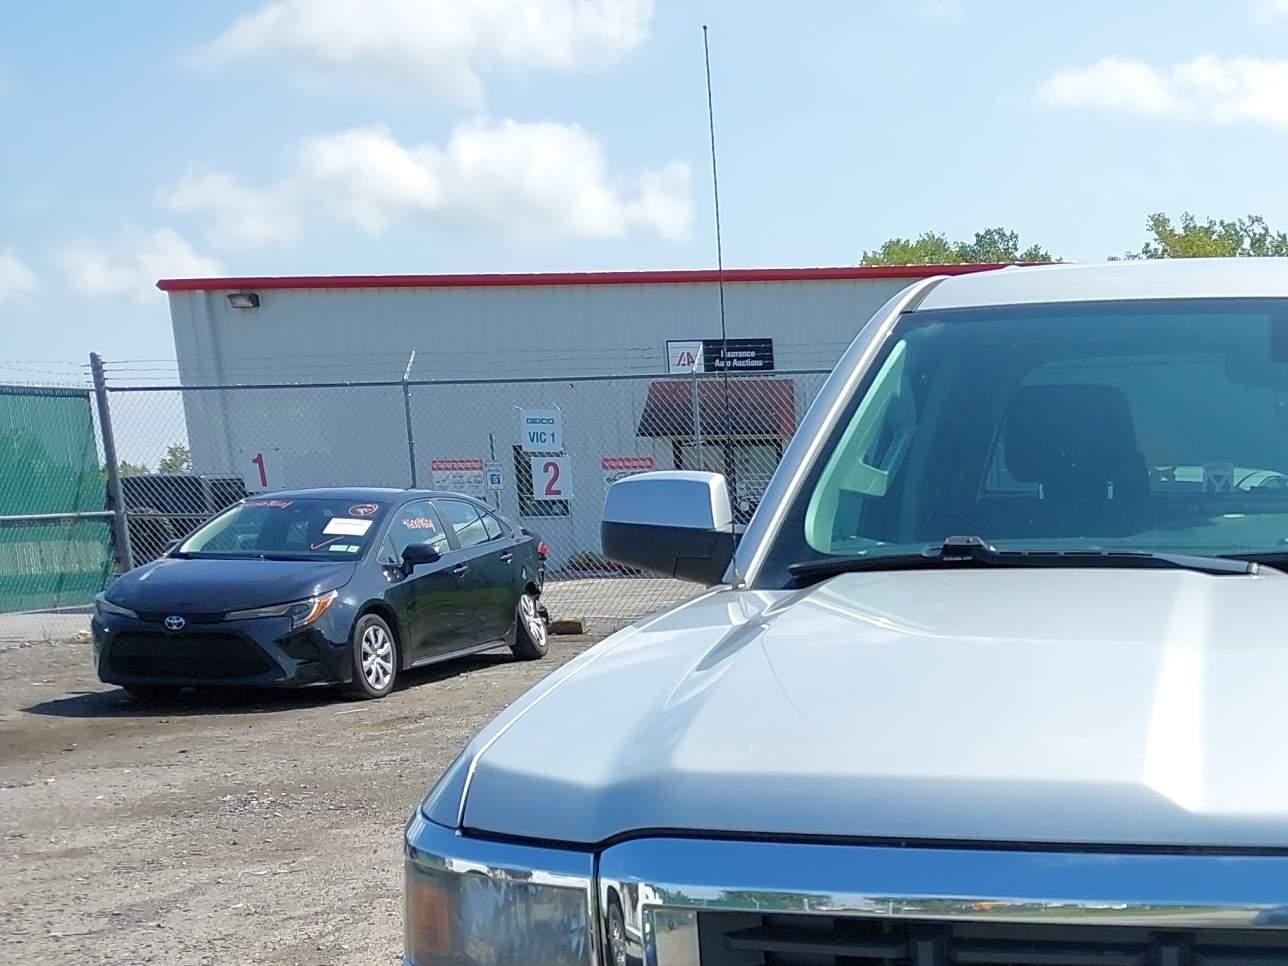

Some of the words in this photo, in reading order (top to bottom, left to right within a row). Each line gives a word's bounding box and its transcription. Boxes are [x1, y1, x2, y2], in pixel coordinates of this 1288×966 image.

[720, 349, 756, 358] Isurance
[714, 358, 731, 368] Auo
[732, 358, 763, 368] Auctions
[528, 431, 546, 443] VIC
[550, 431, 555, 443] 1
[252, 453, 267, 487] 1
[543, 461, 561, 496] 2
